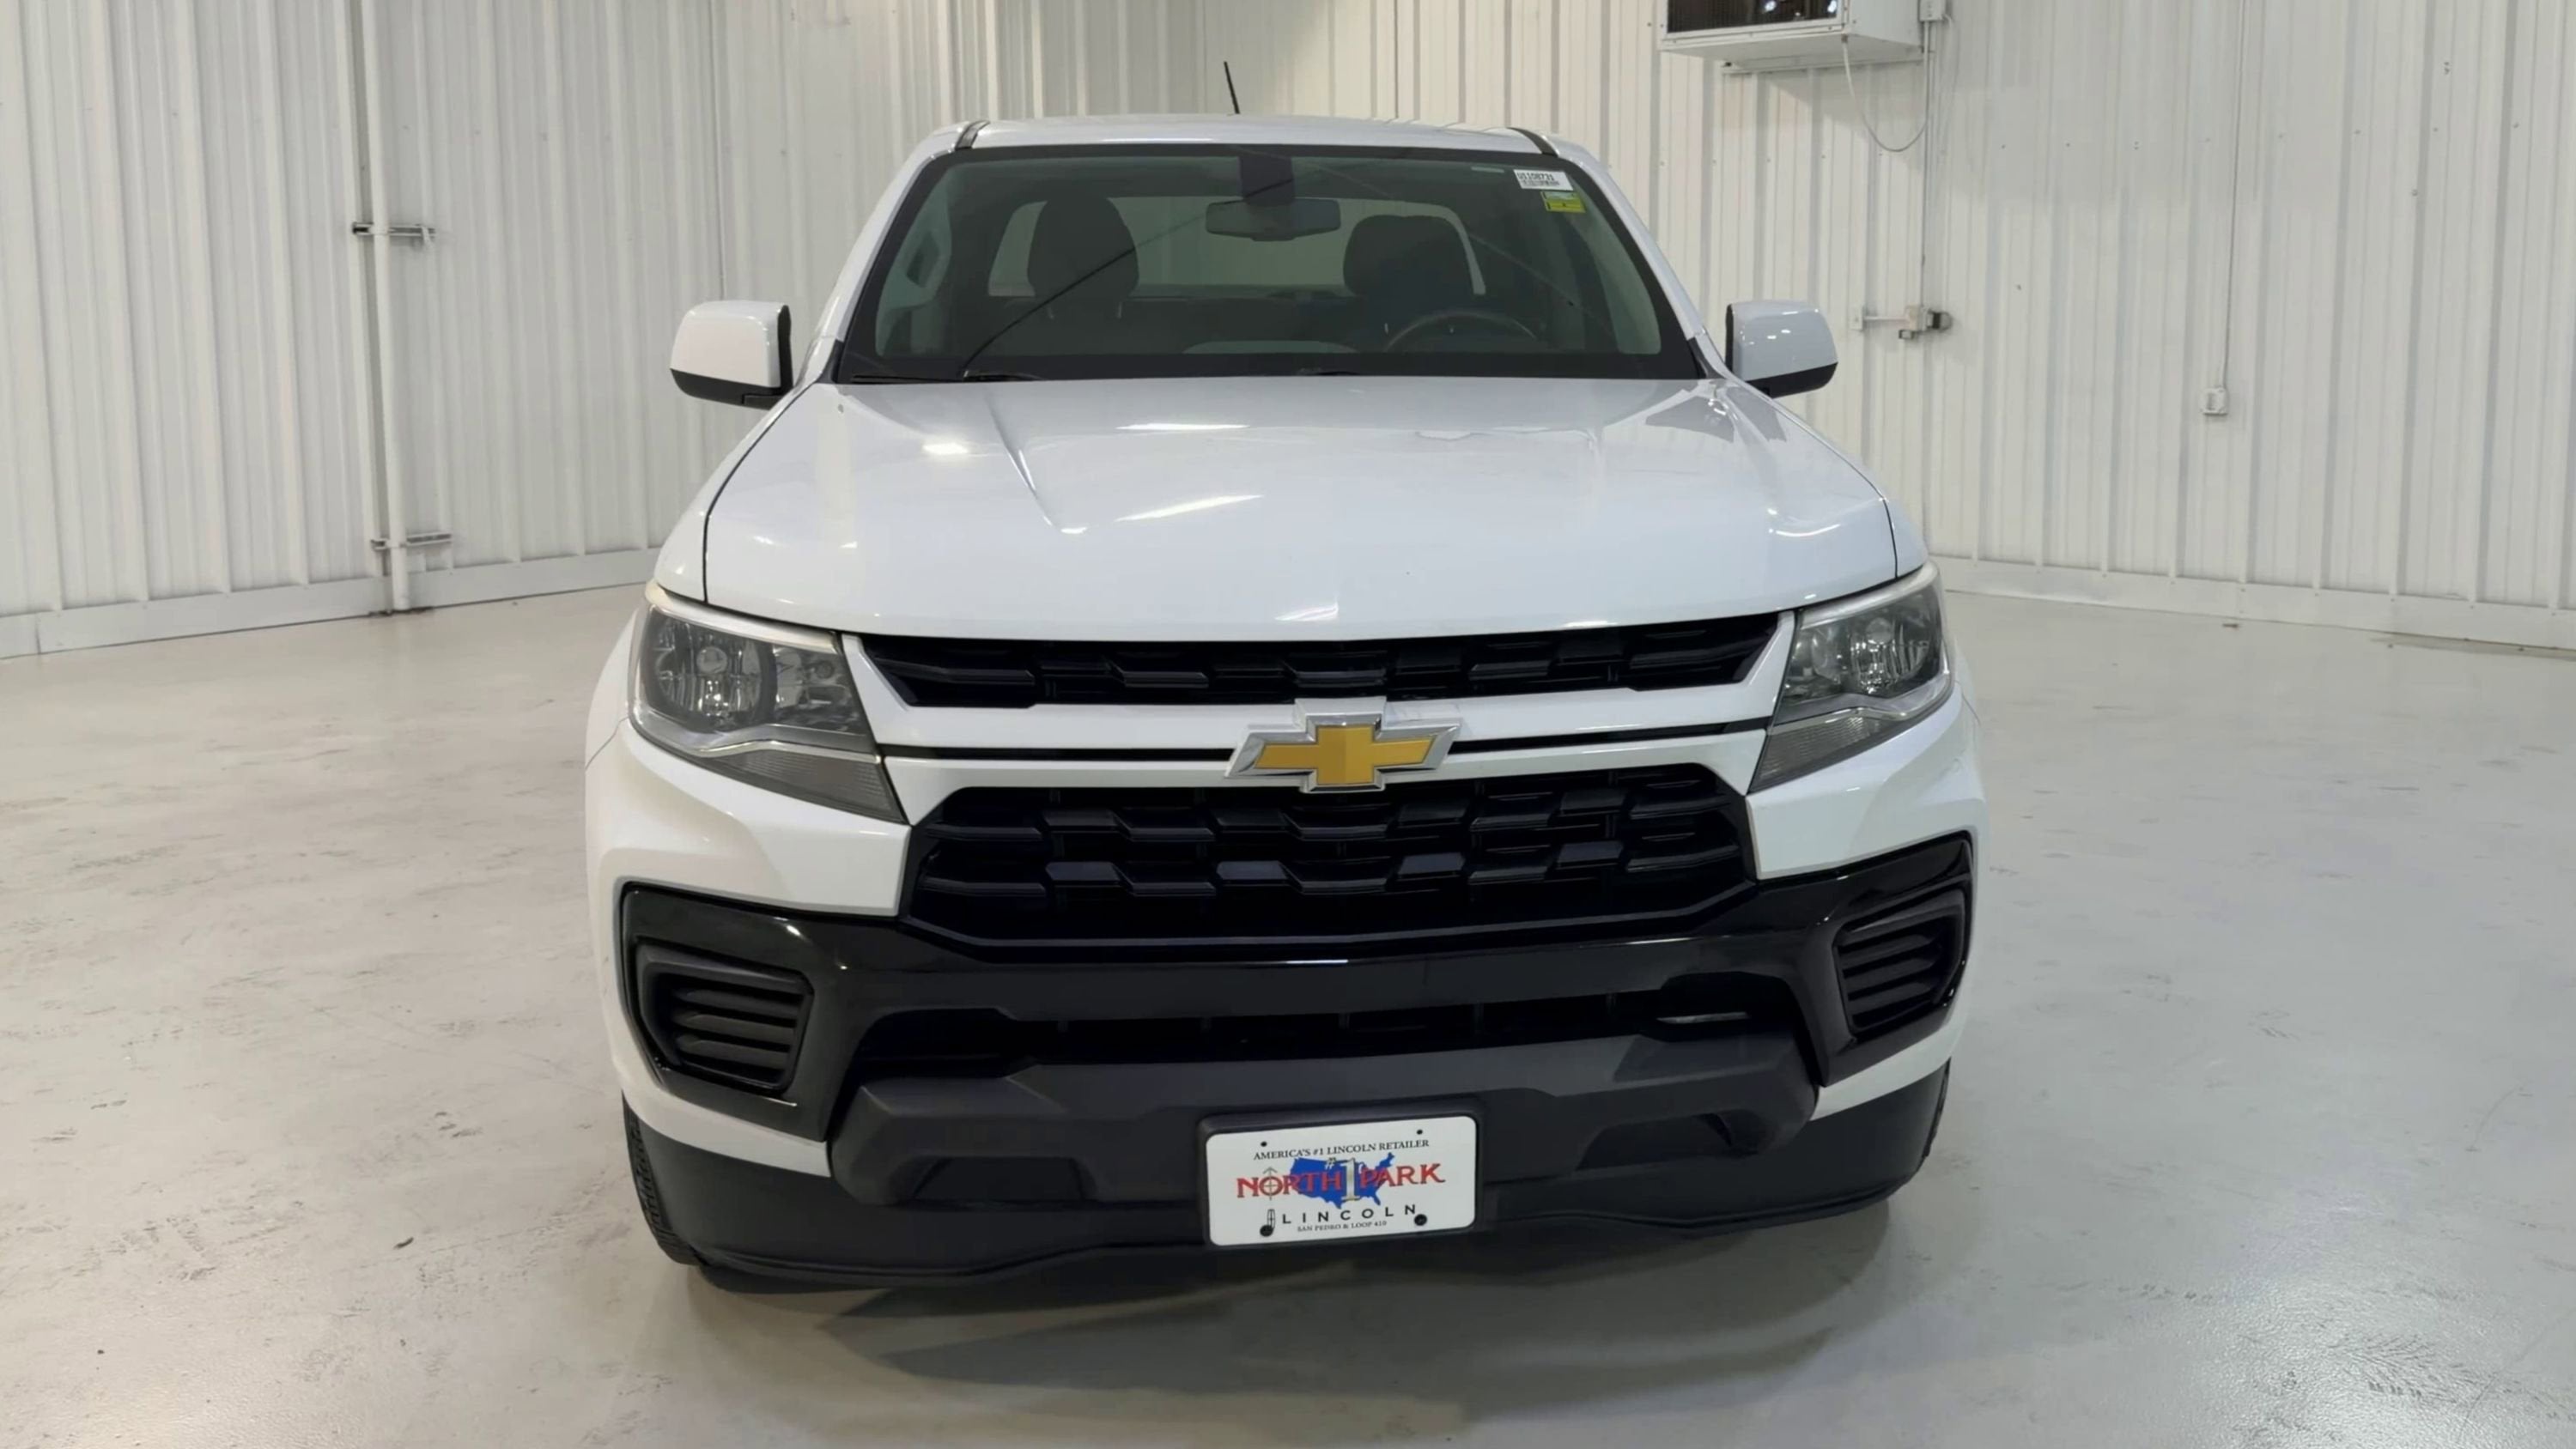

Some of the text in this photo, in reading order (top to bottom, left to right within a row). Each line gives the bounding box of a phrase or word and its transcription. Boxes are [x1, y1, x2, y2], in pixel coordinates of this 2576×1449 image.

[1254, 1139, 1430, 1161] AMERICA'S #1 LINCOLN RETAILER
[1236, 1163, 1446, 1197] NORTH PARK
[1282, 1203, 1416, 1224] LINCOLN
[1315, 1223, 1341, 1232] PEDRO
